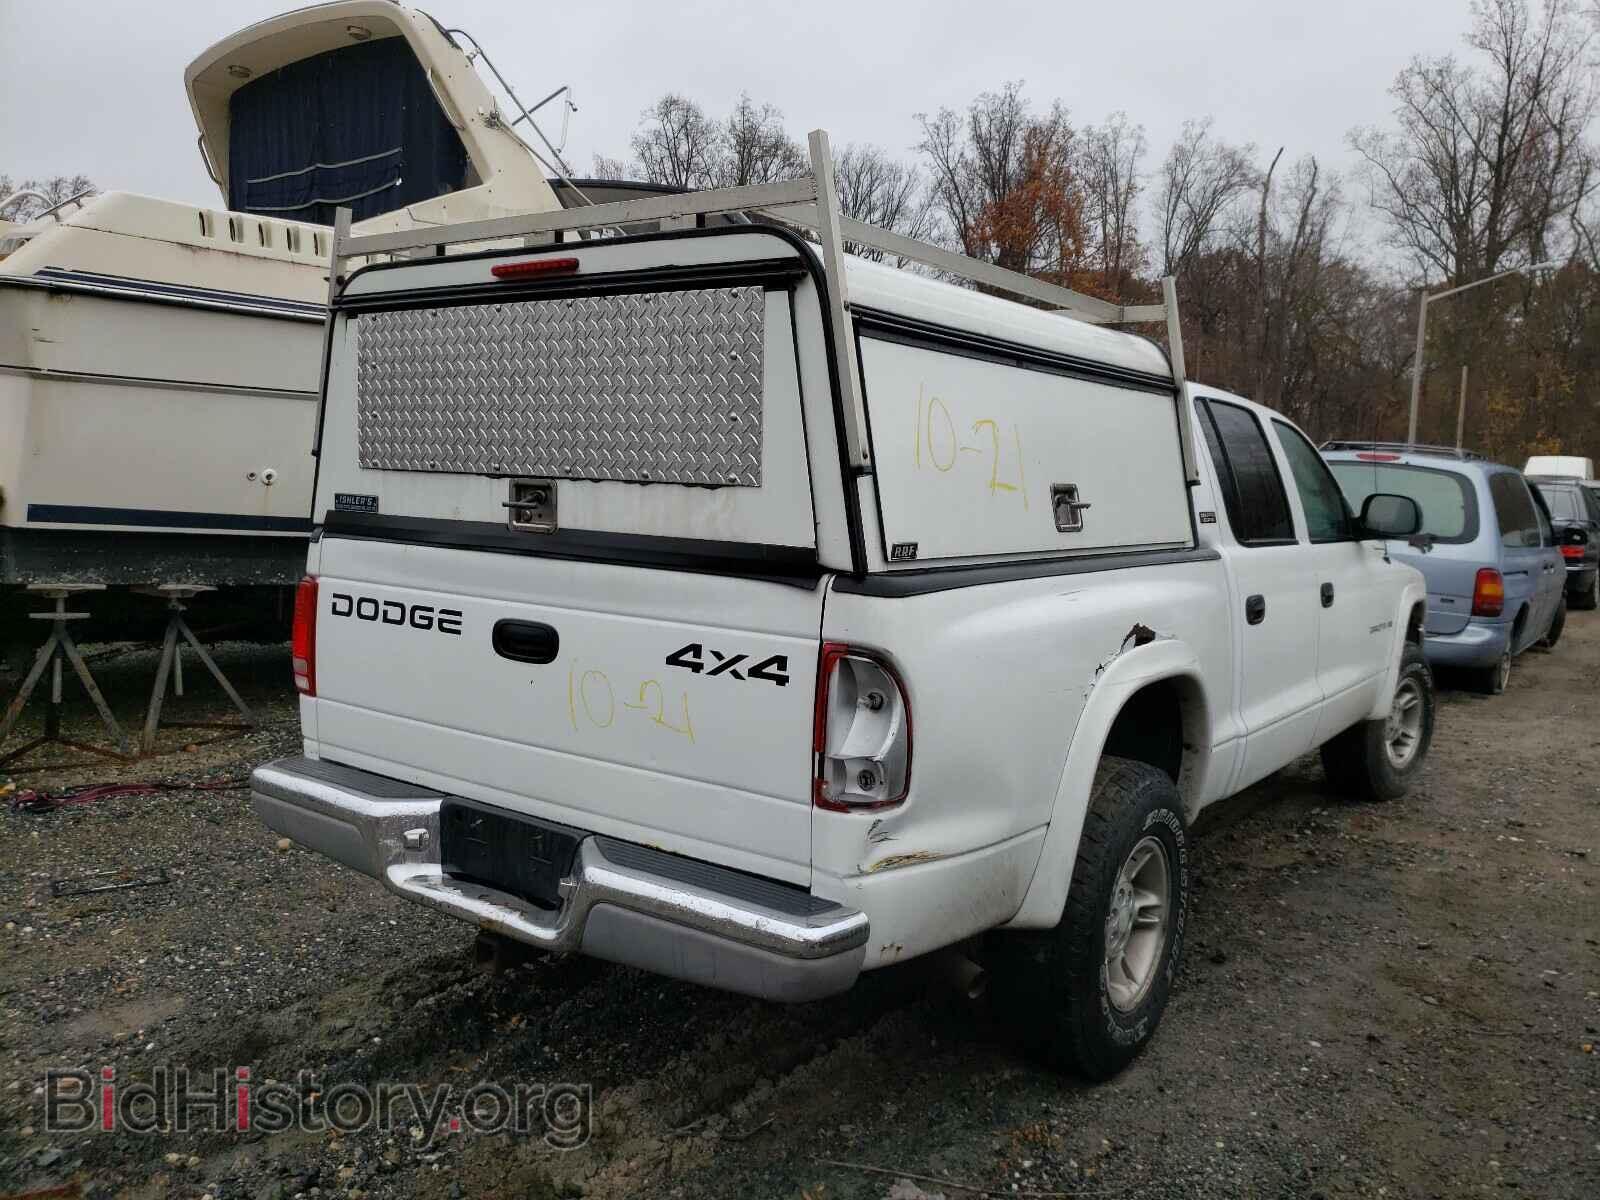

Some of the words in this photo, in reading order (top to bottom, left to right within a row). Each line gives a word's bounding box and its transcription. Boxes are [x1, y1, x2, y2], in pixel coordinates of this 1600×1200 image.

[913, 381, 1029, 511] 10-21
[331, 592, 463, 635] DODGE
[567, 657, 695, 744] 10-21
